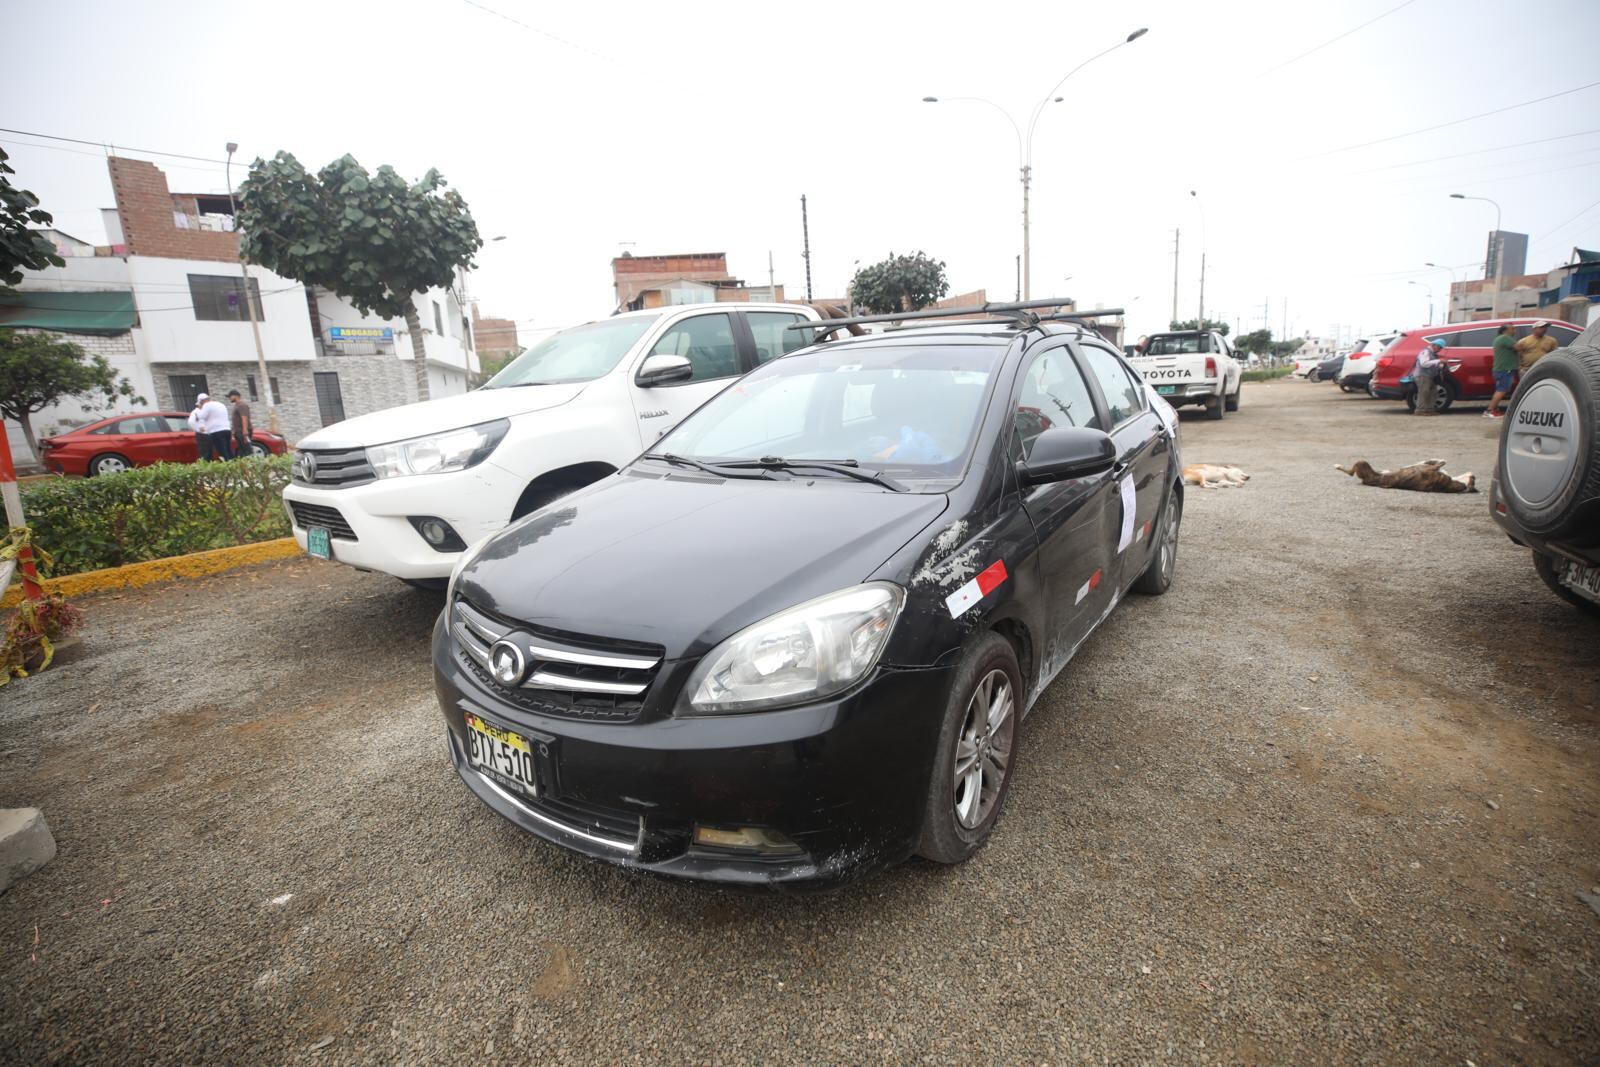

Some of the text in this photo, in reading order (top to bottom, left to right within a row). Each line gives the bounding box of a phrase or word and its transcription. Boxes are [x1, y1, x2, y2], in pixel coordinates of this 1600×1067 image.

[1143, 369, 1192, 380] TOYOTA
[640, 410, 669, 420] HILUX
[1519, 410, 1564, 428] SUZUKI
[467, 726, 535, 787] BTX-510
